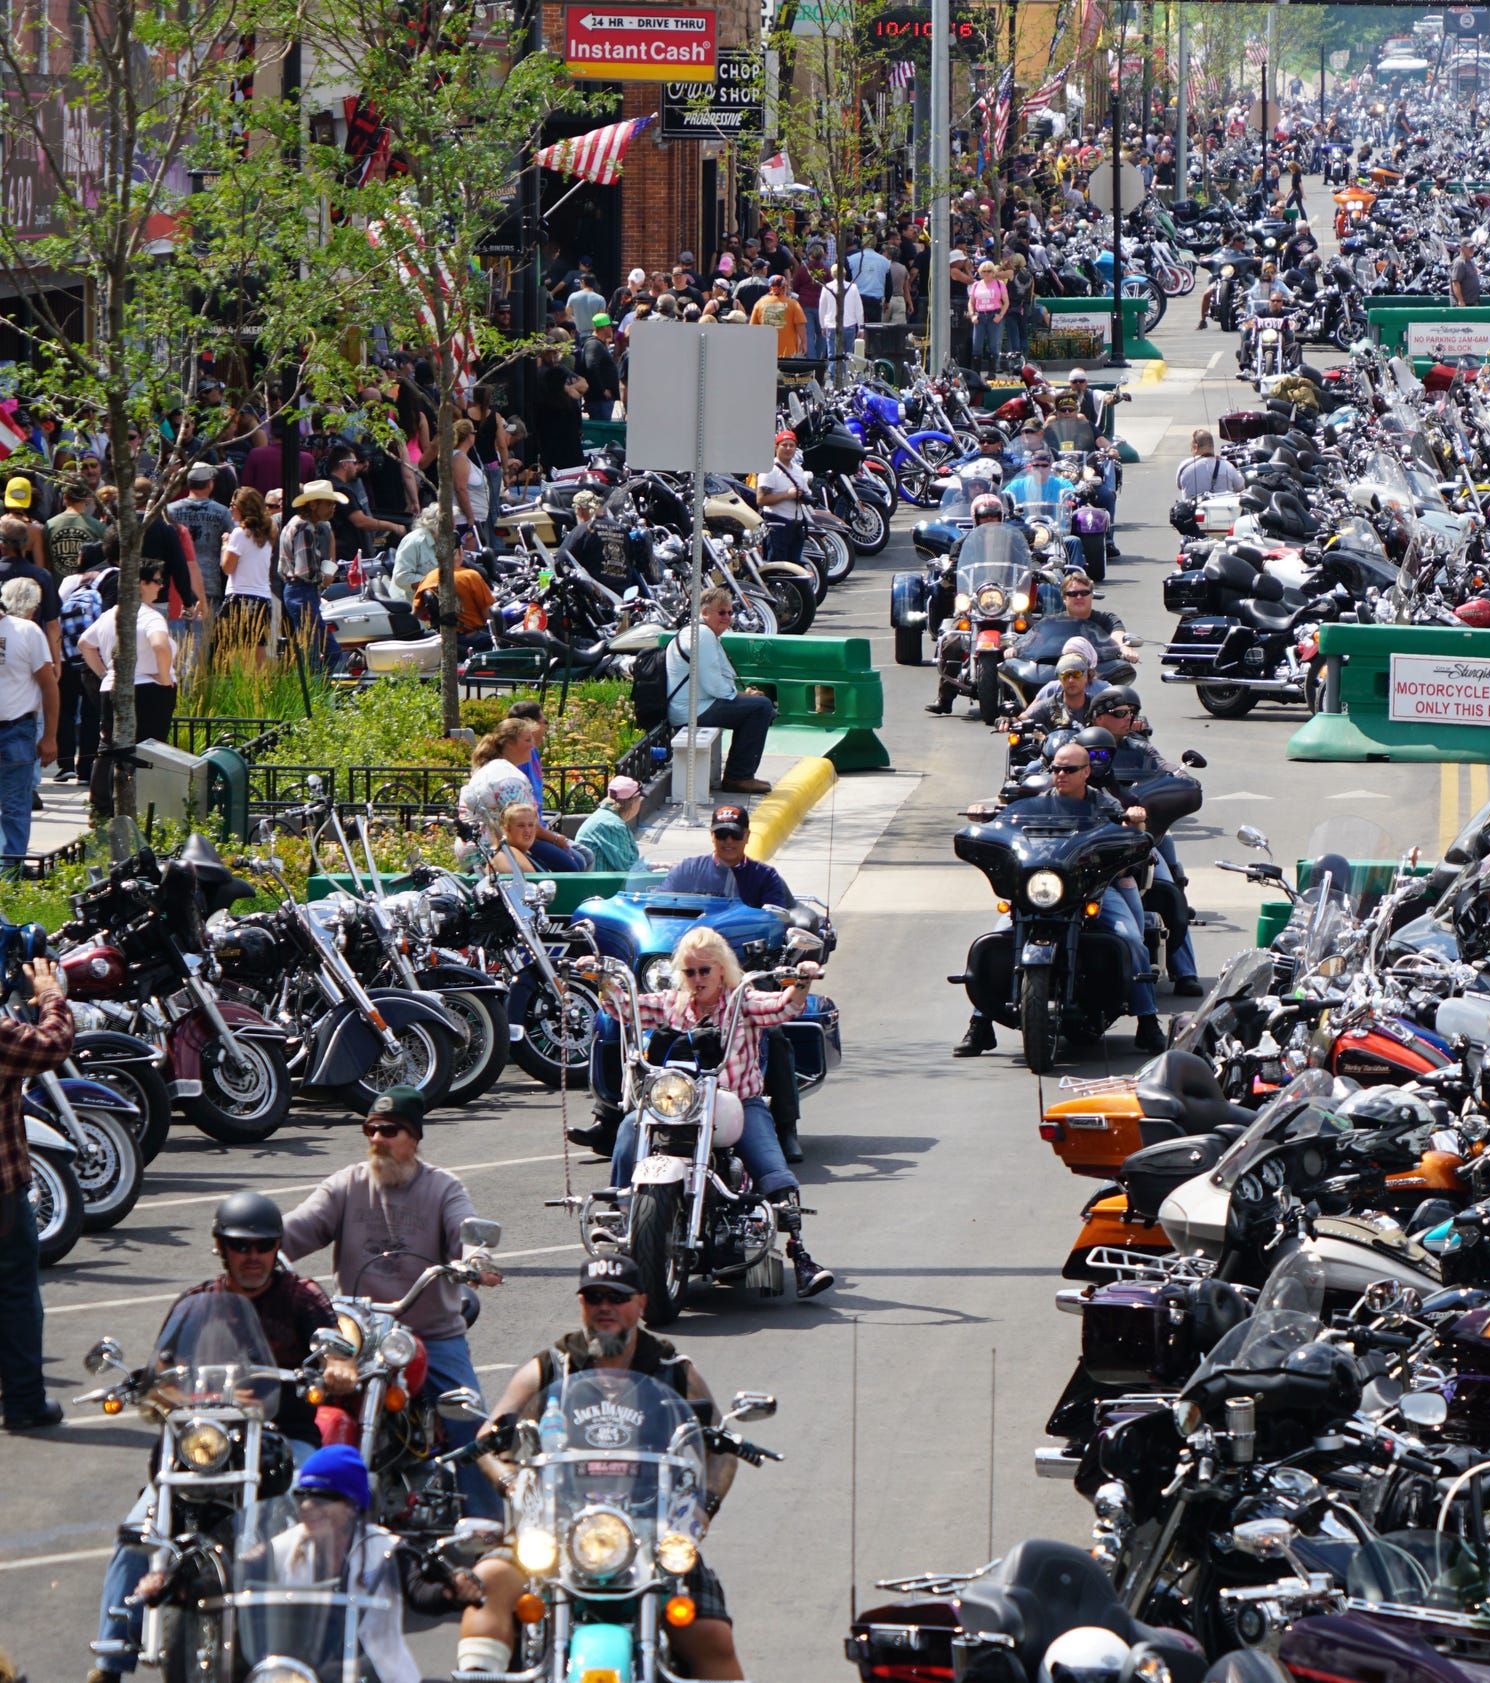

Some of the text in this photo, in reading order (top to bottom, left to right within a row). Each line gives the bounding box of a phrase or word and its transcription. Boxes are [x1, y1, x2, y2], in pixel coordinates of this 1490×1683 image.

[591, 17, 604, 27] 24
[608, 18, 624, 27] HR
[637, 18, 670, 29] DRIVE
[674, 19, 705, 30] THRU
[570, 39, 705, 61] Instant Cash
[719, 63, 761, 79] CHOP
[720, 87, 761, 103] SHOP
[683, 112, 742, 127] PROGRESSIVE
[1397, 682, 1490, 699] MOTORCYCLE
[1415, 701, 1450, 714] ONLY
[1454, 703, 1483, 717] THIS
[573, 1404, 601, 1426] JACK
